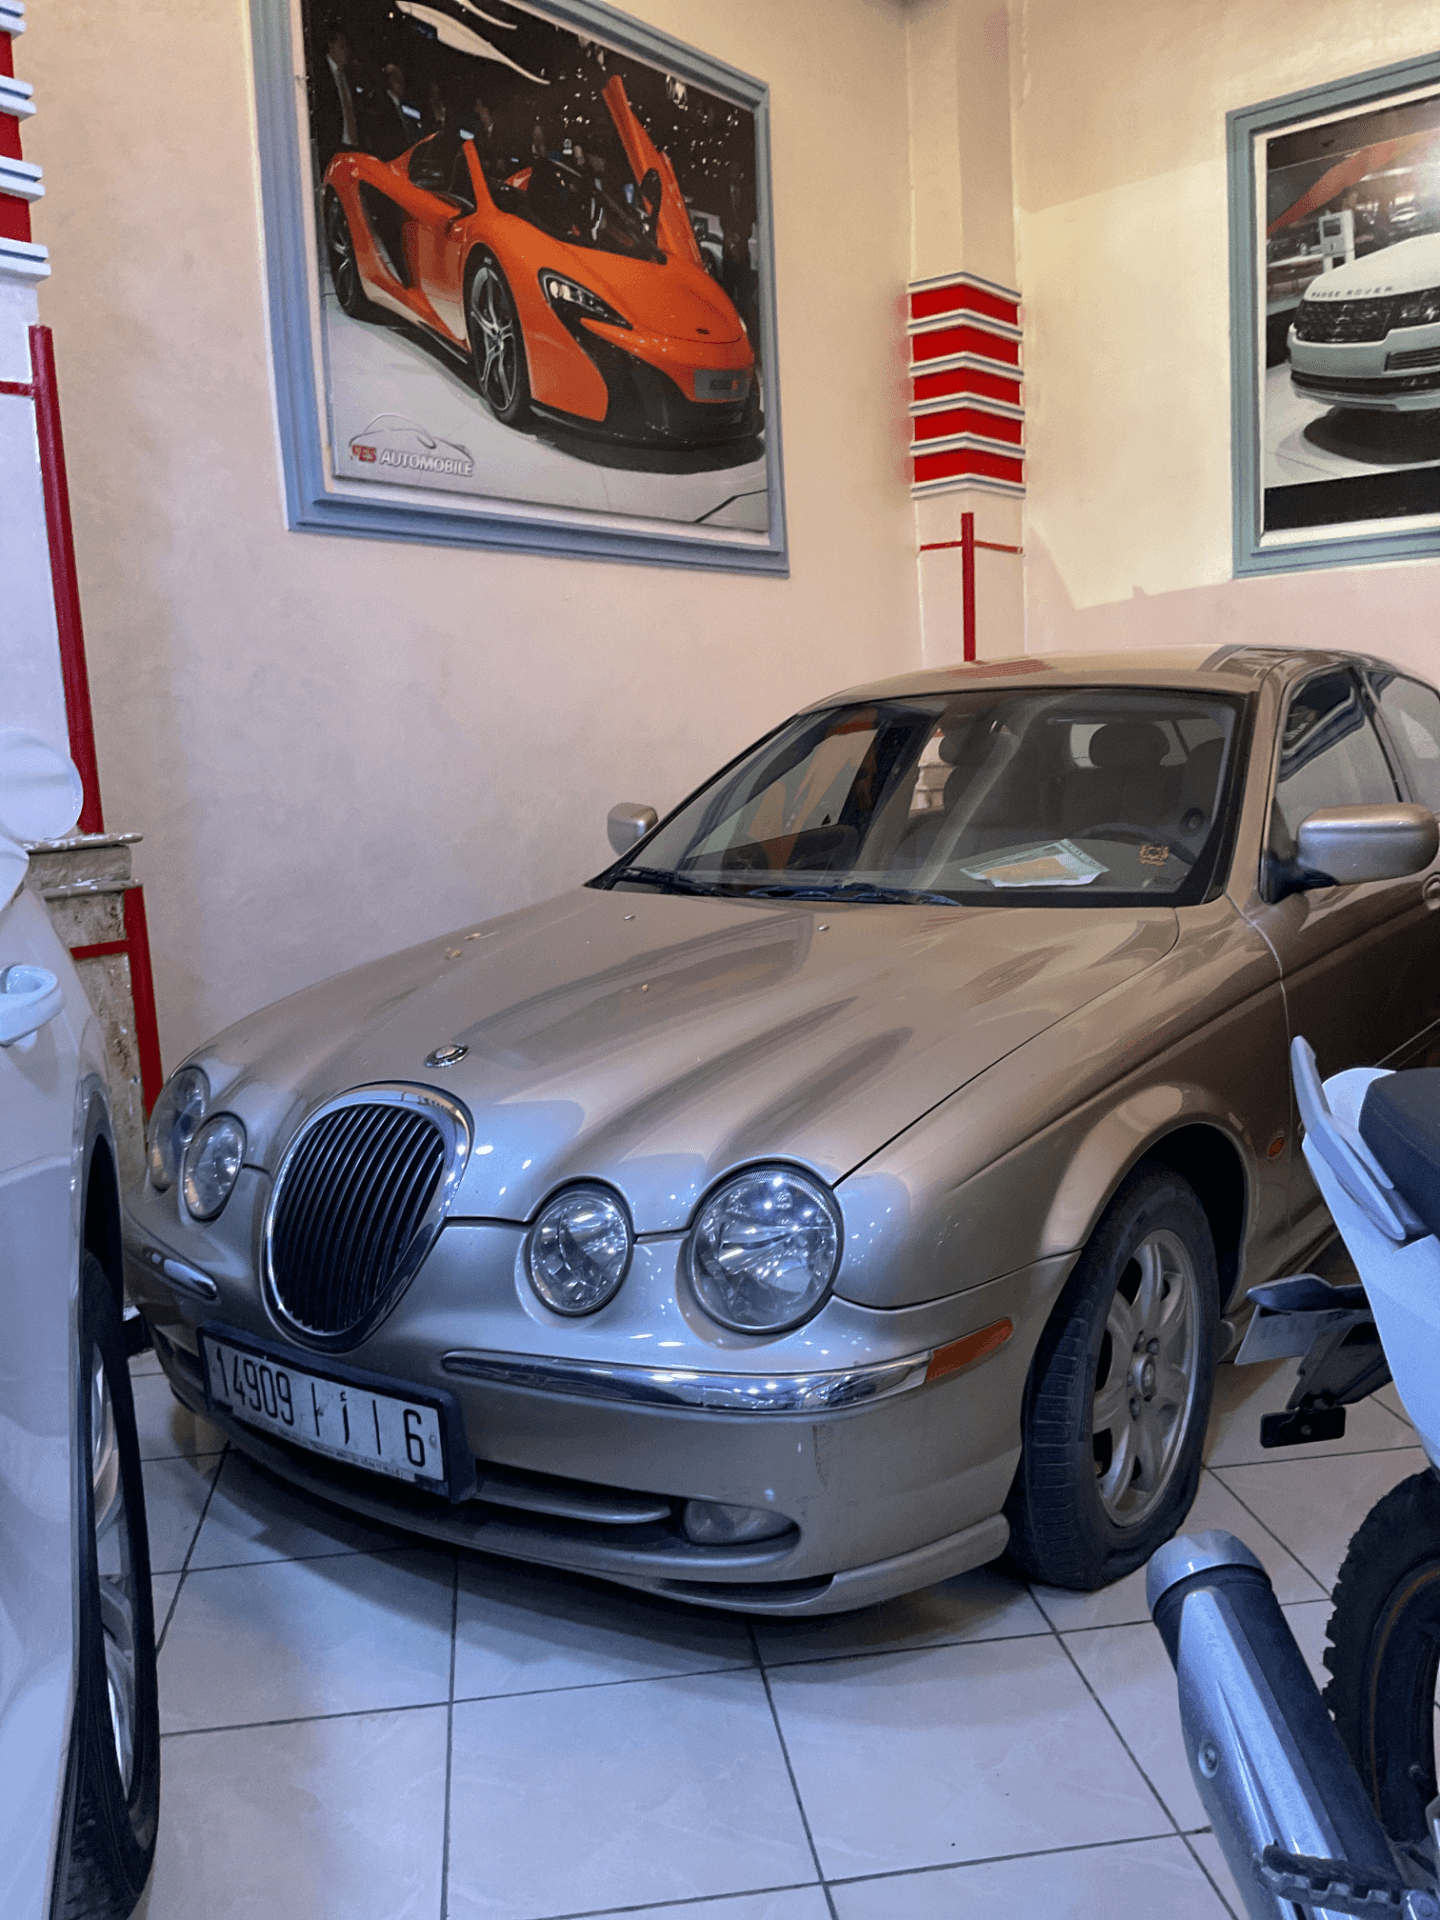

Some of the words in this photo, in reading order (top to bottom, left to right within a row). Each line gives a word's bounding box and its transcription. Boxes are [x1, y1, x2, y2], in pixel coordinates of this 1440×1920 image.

[379, 449, 474, 478] AUTOMOBILE
[215, 1346, 295, 1427] 14909
[402, 1408, 426, 1468] 6
